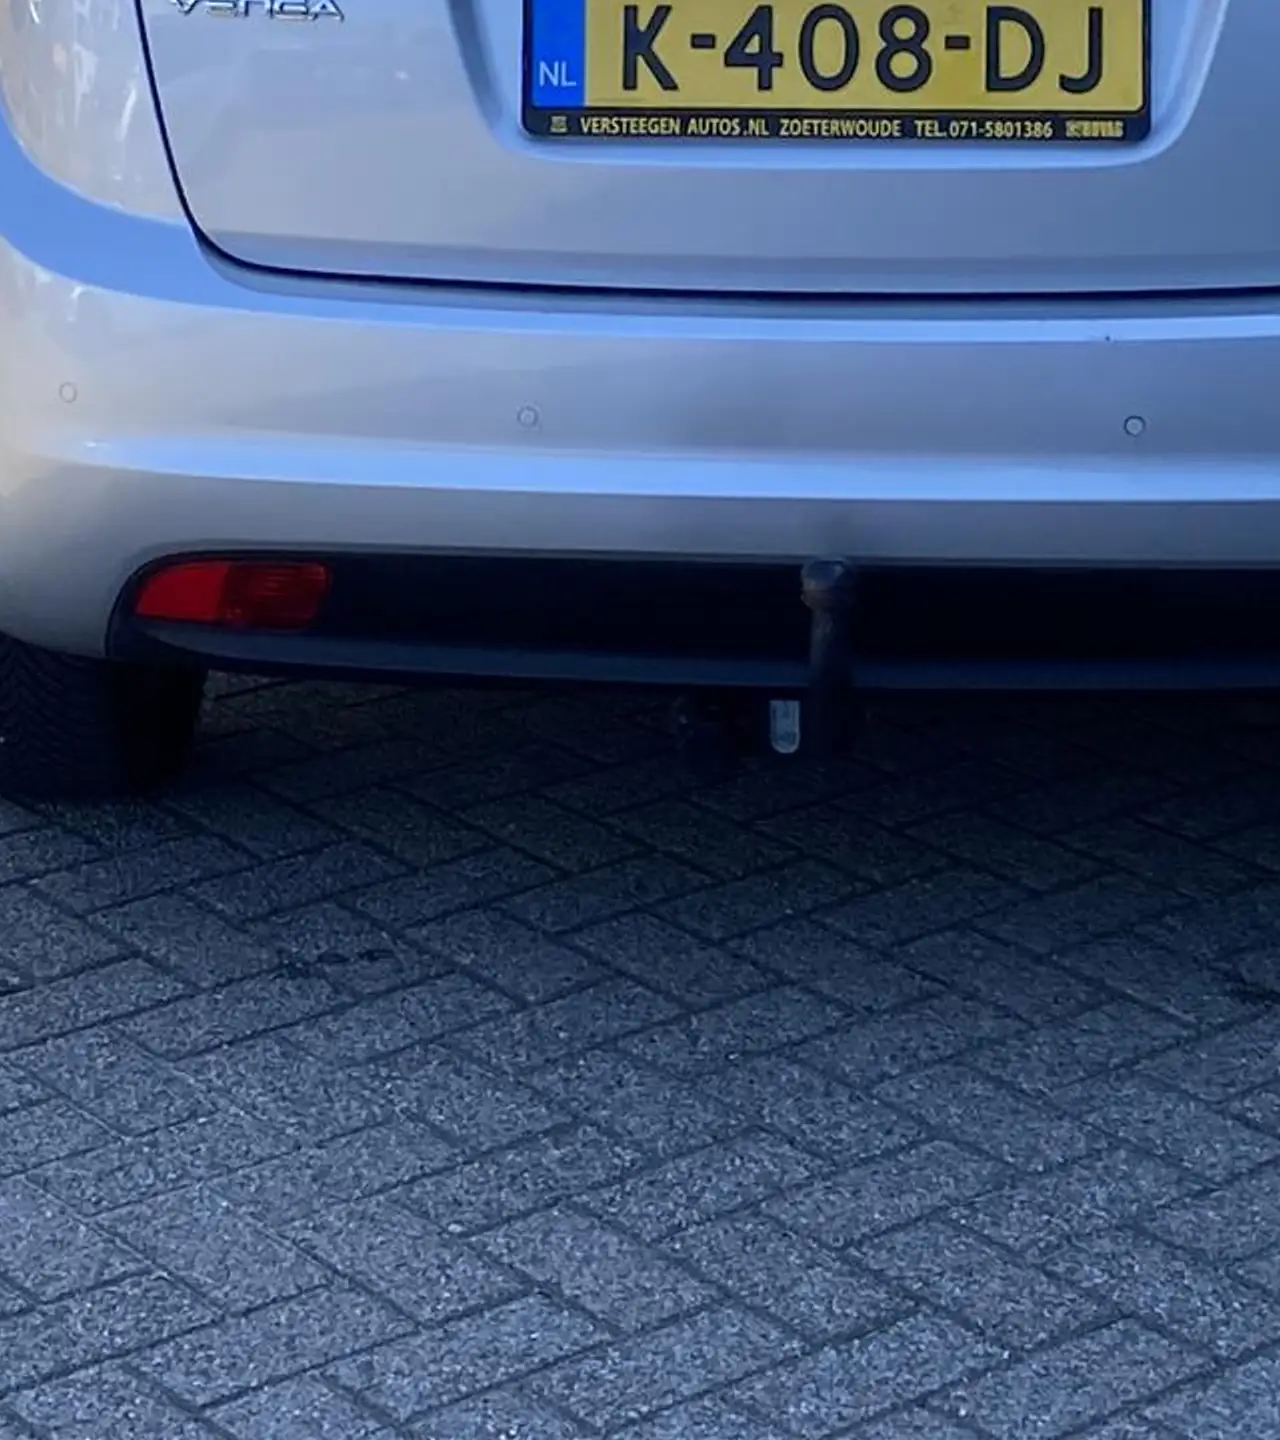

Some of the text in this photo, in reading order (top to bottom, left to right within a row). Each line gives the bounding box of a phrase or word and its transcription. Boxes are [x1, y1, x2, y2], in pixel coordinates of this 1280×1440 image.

[622, 4, 1104, 93] K-408-DJ
[538, 62, 576, 88] NL
[579, 116, 681, 134] VERSTEEGEN
[779, 118, 902, 137] ZOETERWOUDE
